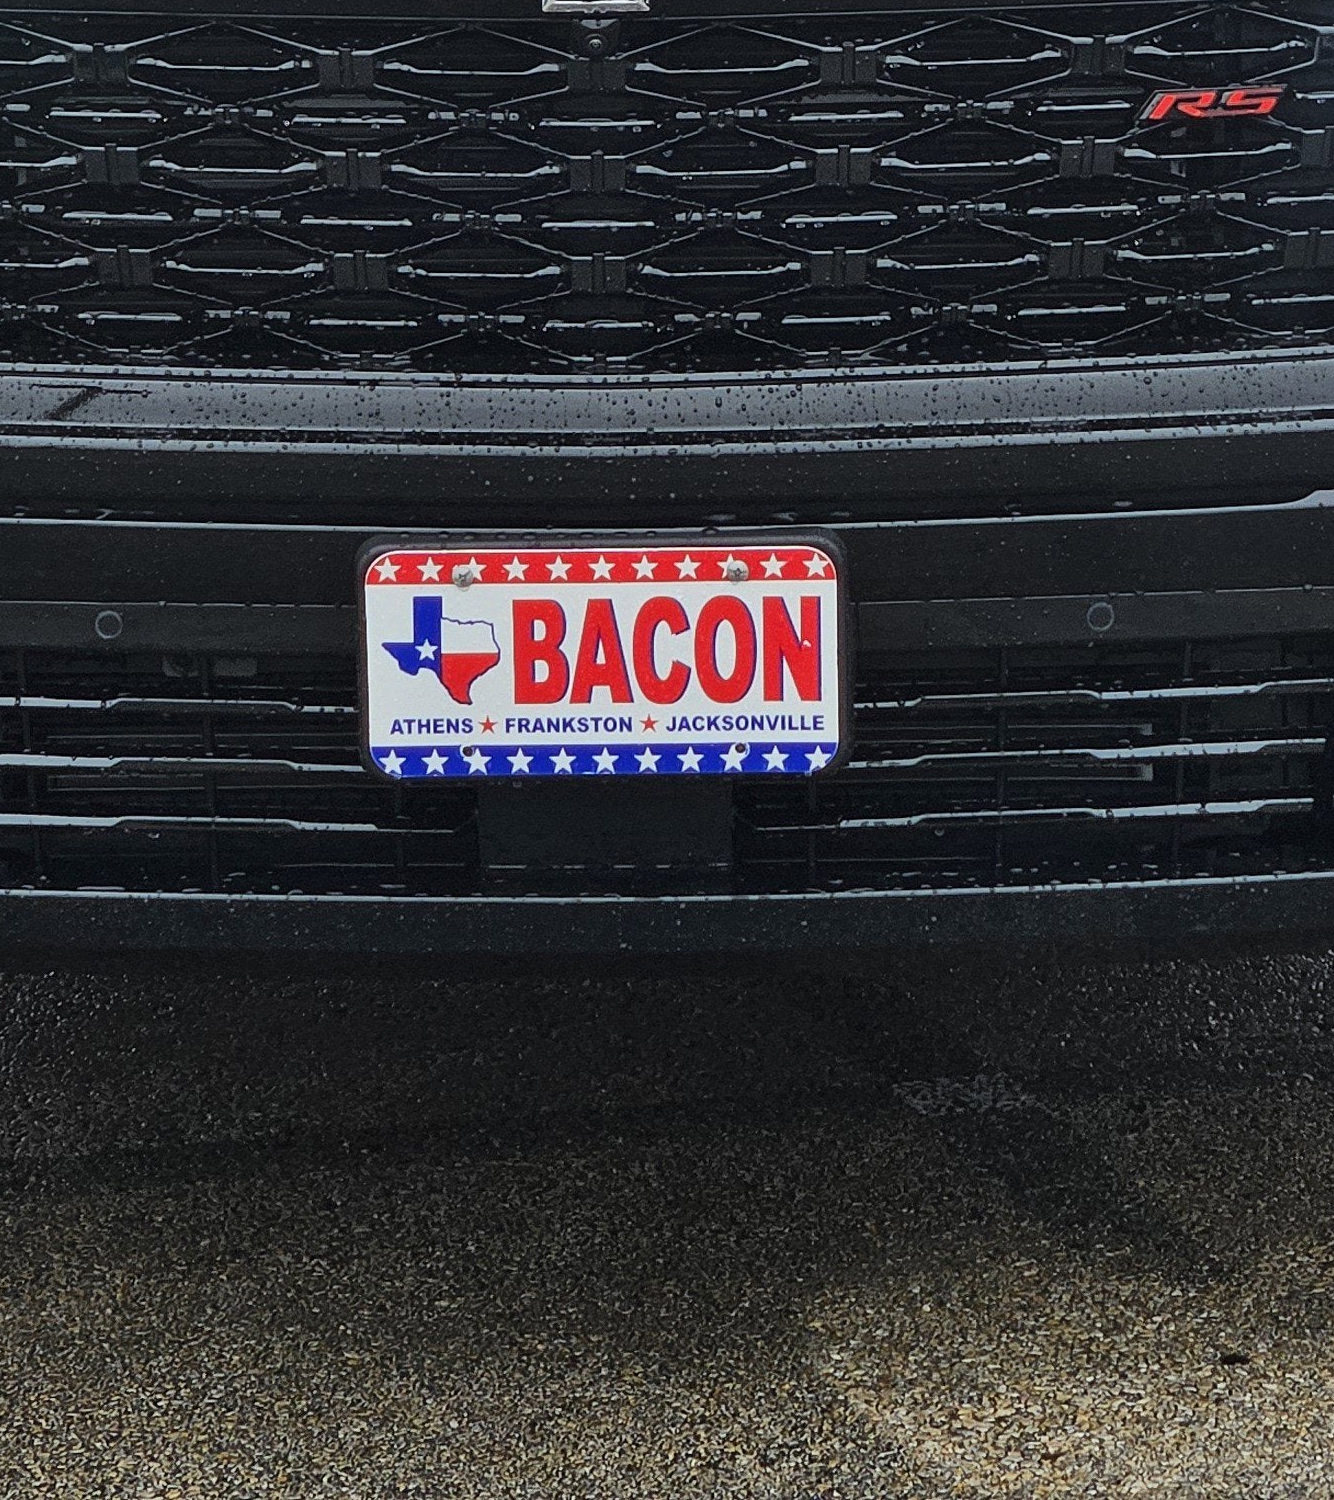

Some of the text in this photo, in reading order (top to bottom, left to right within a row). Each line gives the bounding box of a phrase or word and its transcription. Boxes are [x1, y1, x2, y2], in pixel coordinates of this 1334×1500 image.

[1140, 87, 1286, 120] RS
[511, 594, 822, 705] BACON
[390, 714, 825, 735] ATHENS FRANKSTON JACKSONVILLE
